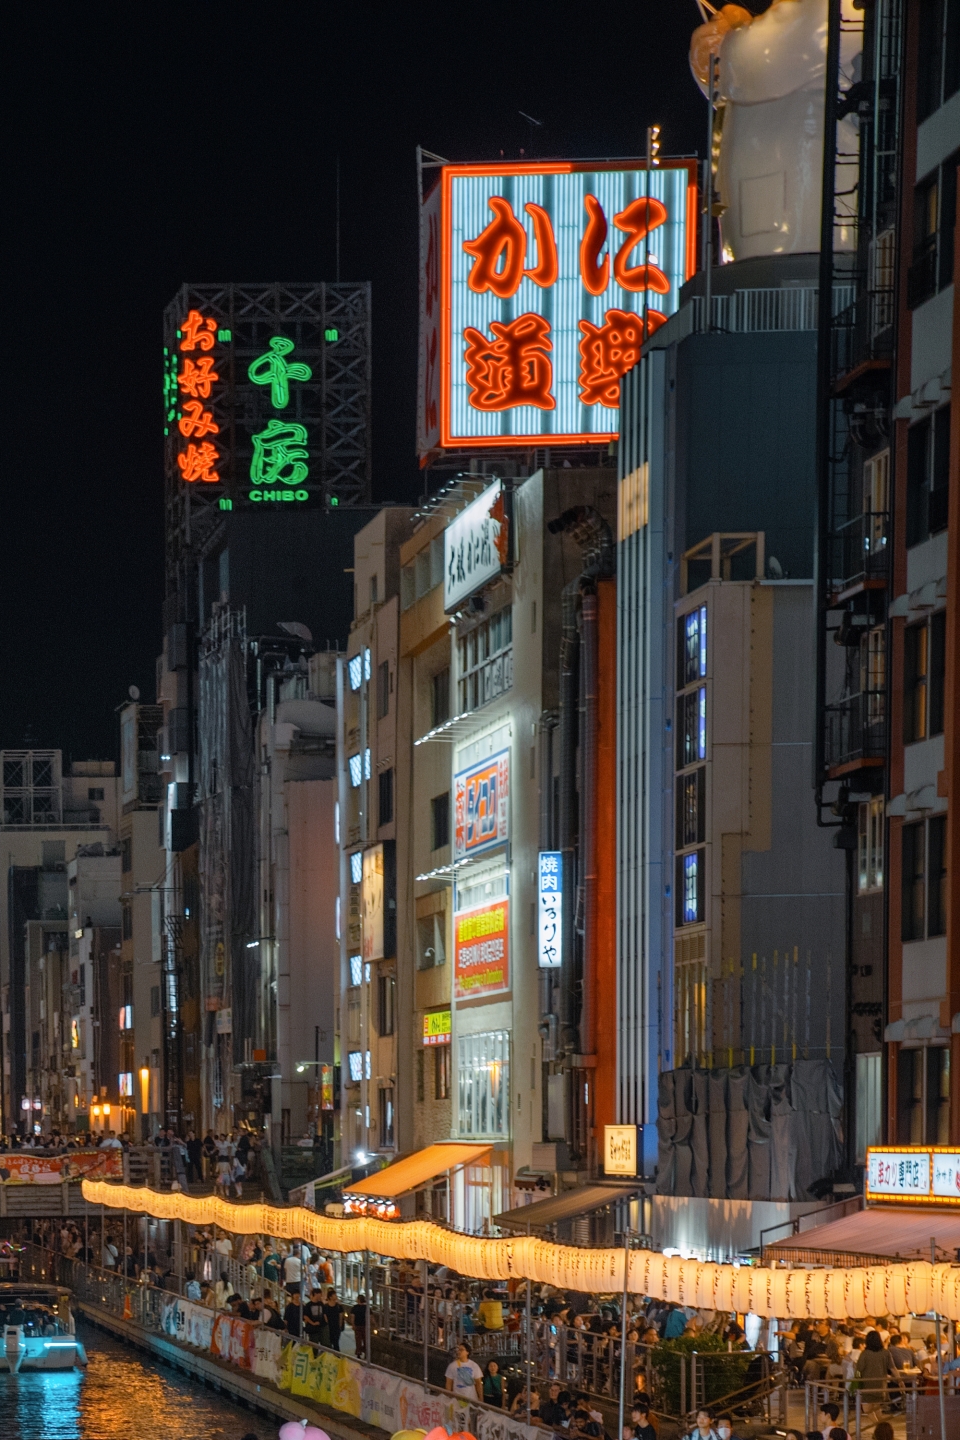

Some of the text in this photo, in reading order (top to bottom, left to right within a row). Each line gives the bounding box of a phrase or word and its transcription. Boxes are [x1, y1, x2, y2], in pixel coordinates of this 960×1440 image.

[462, 194, 671, 299] かに
[177, 310, 220, 484] お好み焼
[248, 336, 312, 486] 千房
[248, 489, 310, 503] CHIBO
[541, 856, 558, 964] 焼肉 いろりや
[877, 1159, 920, 1188] 串カツ専門店
